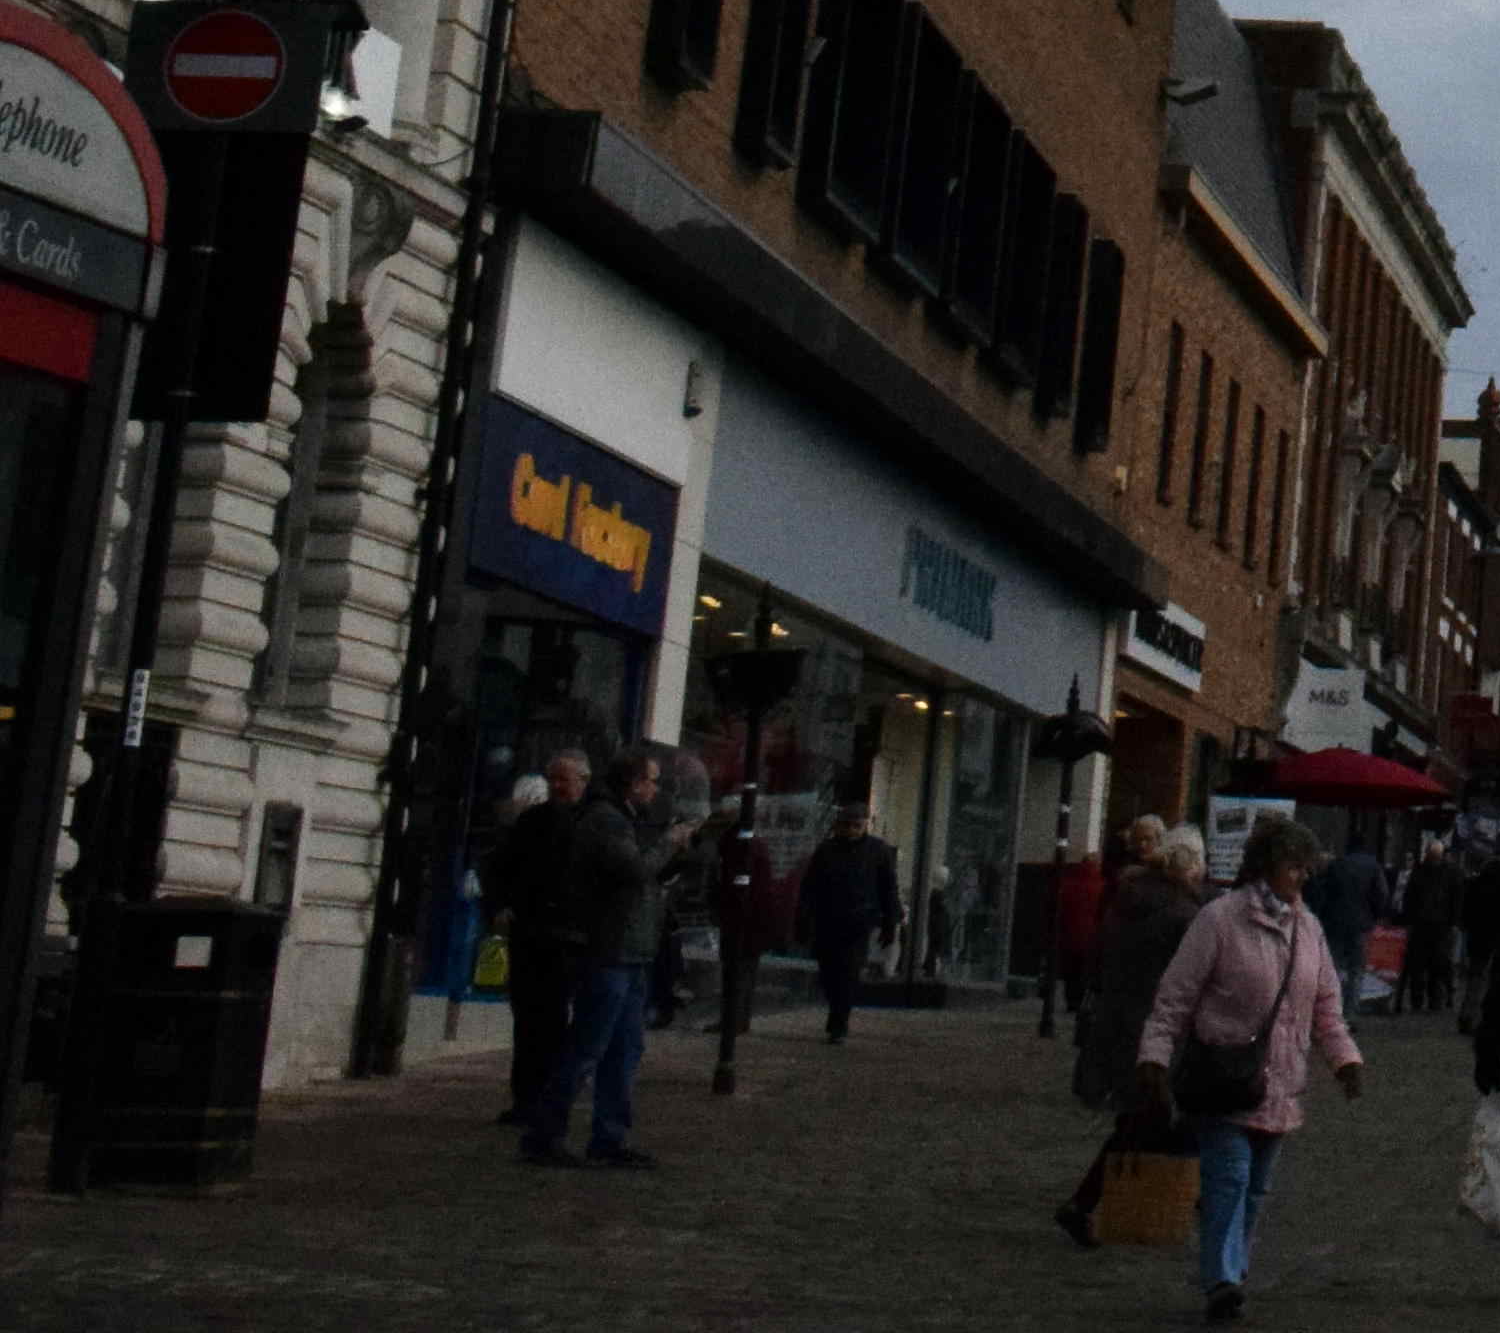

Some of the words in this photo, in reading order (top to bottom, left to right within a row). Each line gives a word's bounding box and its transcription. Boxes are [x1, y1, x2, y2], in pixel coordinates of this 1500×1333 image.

[0, 79, 88, 167] ephone
[16, 219, 83, 279] Cards
[1308, 688, 1349, 707] M&S
